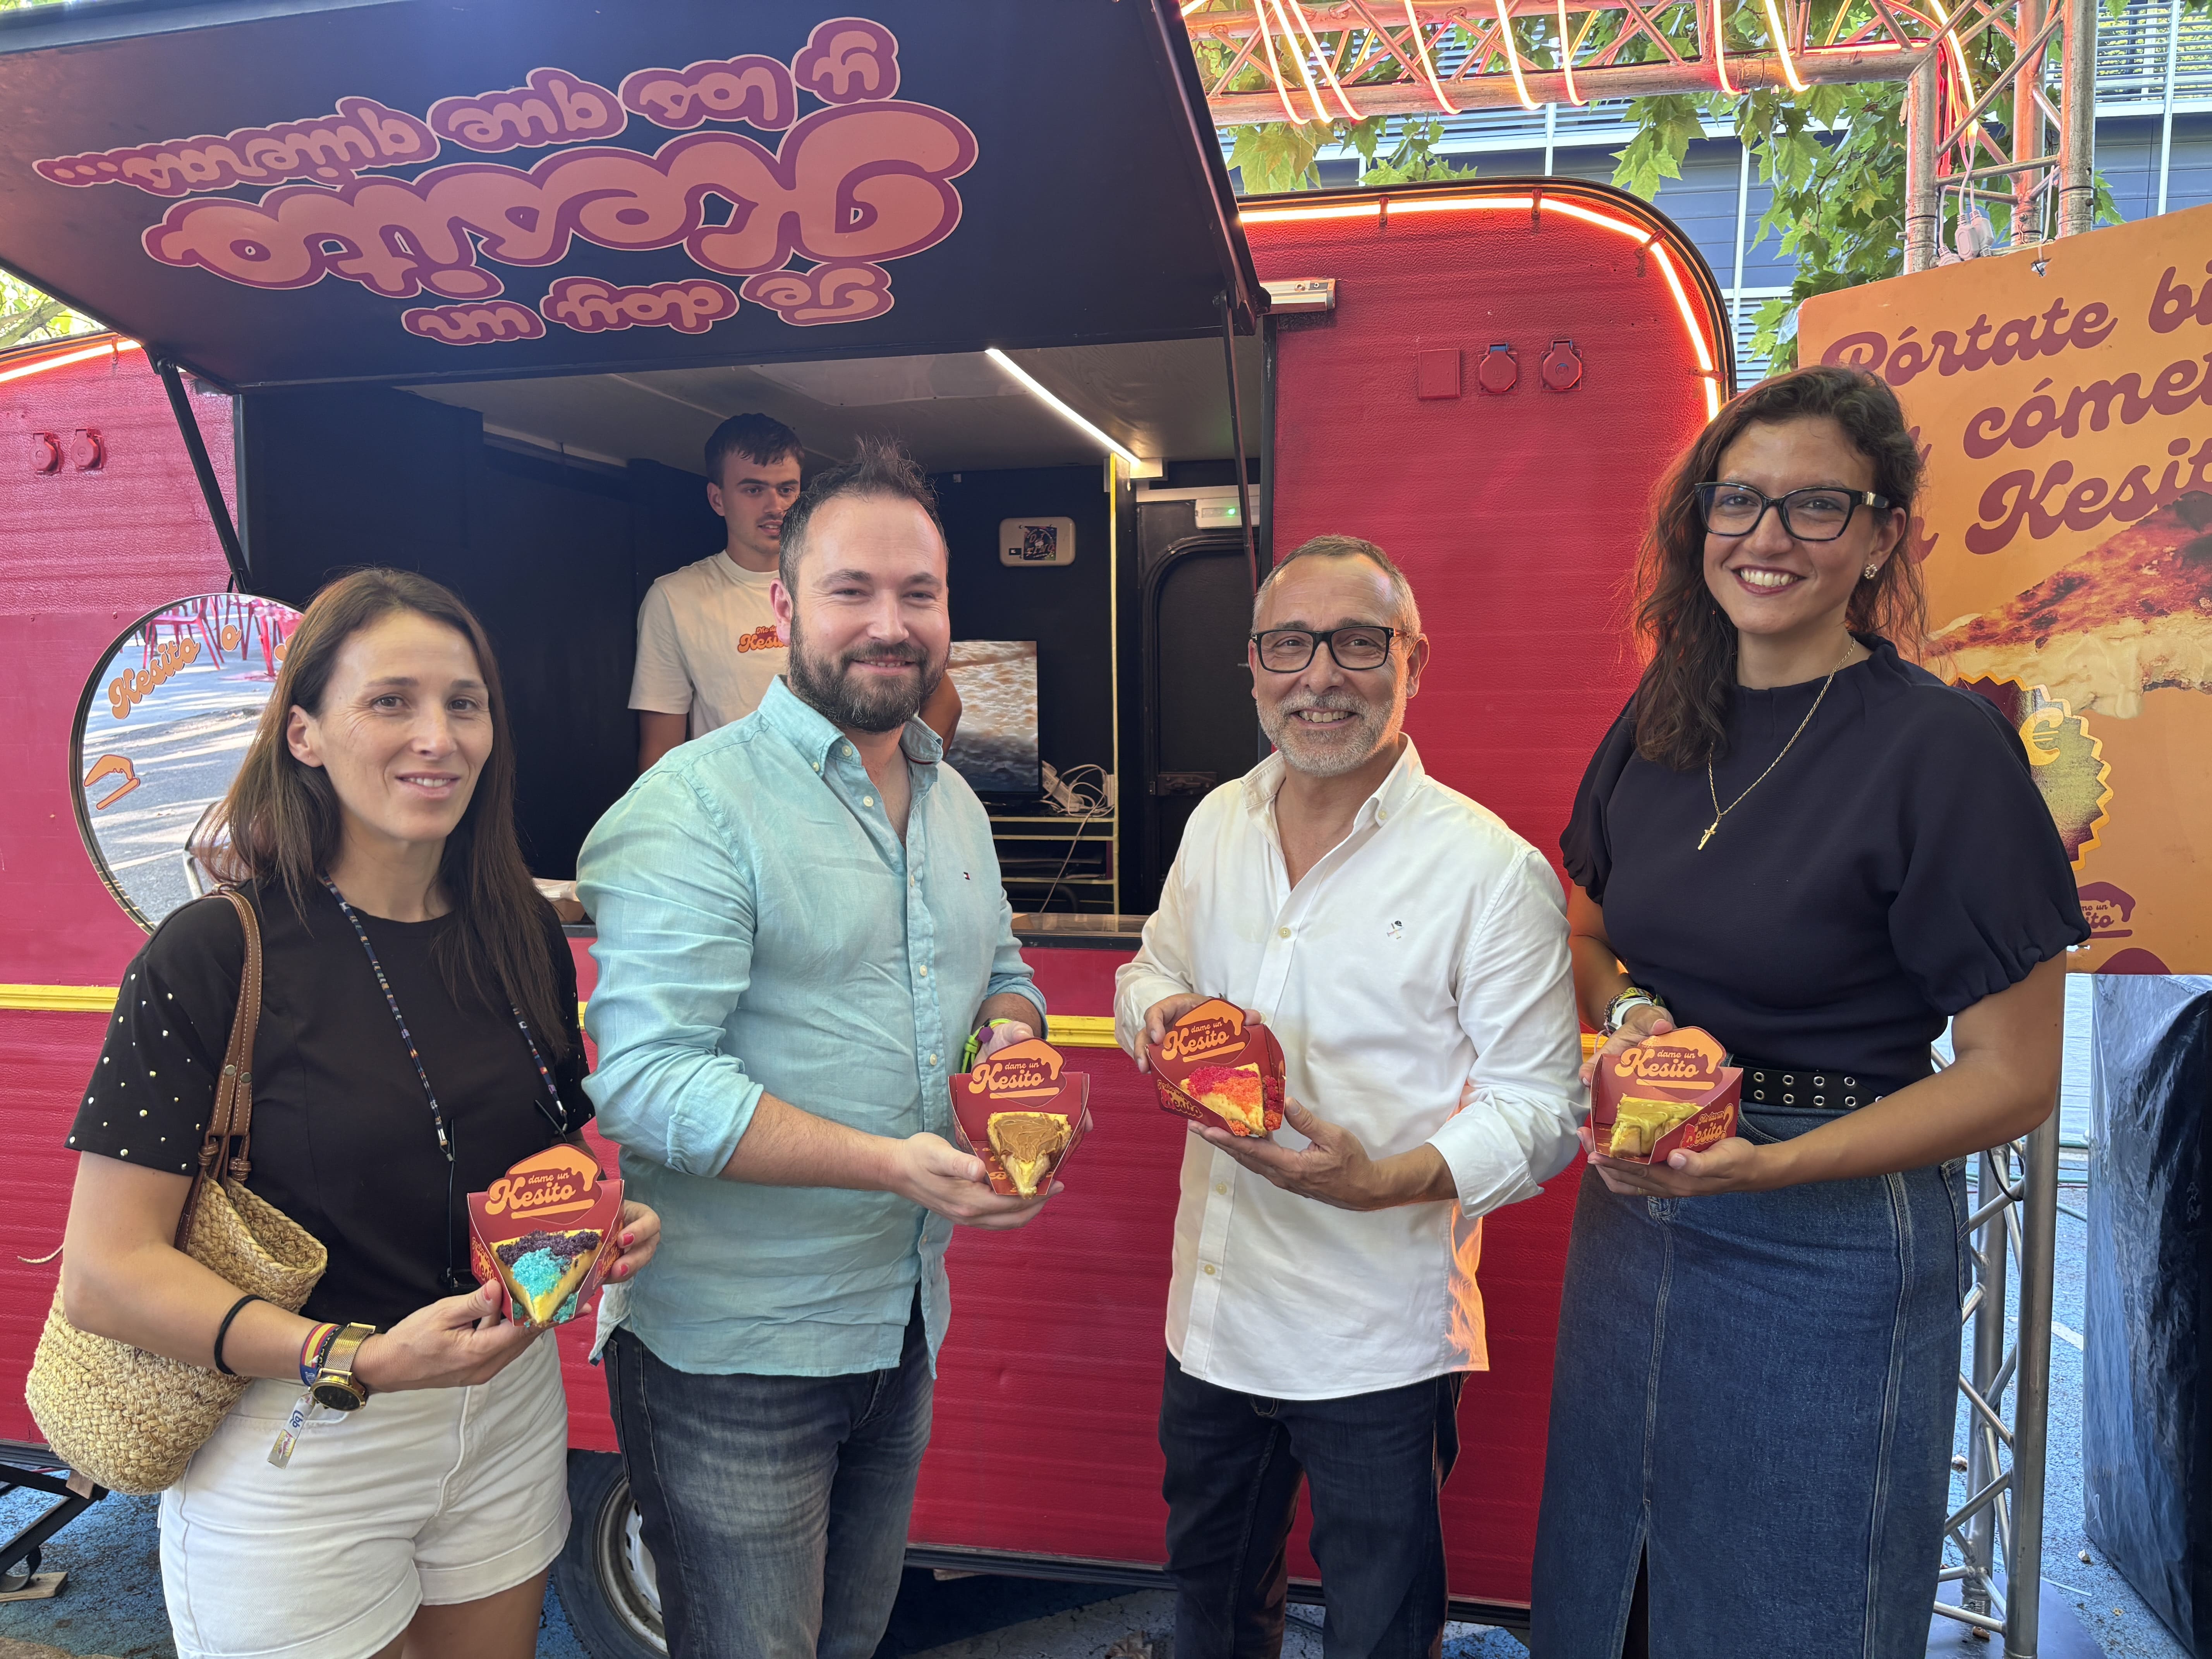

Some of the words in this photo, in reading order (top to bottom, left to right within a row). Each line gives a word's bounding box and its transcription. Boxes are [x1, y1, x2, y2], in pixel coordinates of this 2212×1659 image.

[805, 26, 886, 98] y
[441, 76, 614, 146] que
[633, 62, 785, 124] los
[46, 103, 427, 192] quieras...
[155, 107, 966, 296] Kesito
[552, 282, 729, 329] doy
[751, 266, 883, 321] Te
[413, 306, 536, 342] un
[1820, 297, 2118, 386] Pórtate
[738, 633, 787, 653] Kesi
[108, 637, 201, 719] Kesito
[222, 624, 242, 651] o
[2085, 911, 2115, 929] ito
[1161, 1027, 1230, 1060] Kesito
[1191, 1025, 1211, 1033] dame
[1614, 1048, 1699, 1078] Kesito
[1657, 1049, 1681, 1058] dame
[968, 1063, 1044, 1094] Kesito
[1161, 1091, 1202, 1118] esito
[485, 1176, 576, 1215] Kesito
[528, 1174, 555, 1185] dame
[557, 1171, 570, 1182] un
